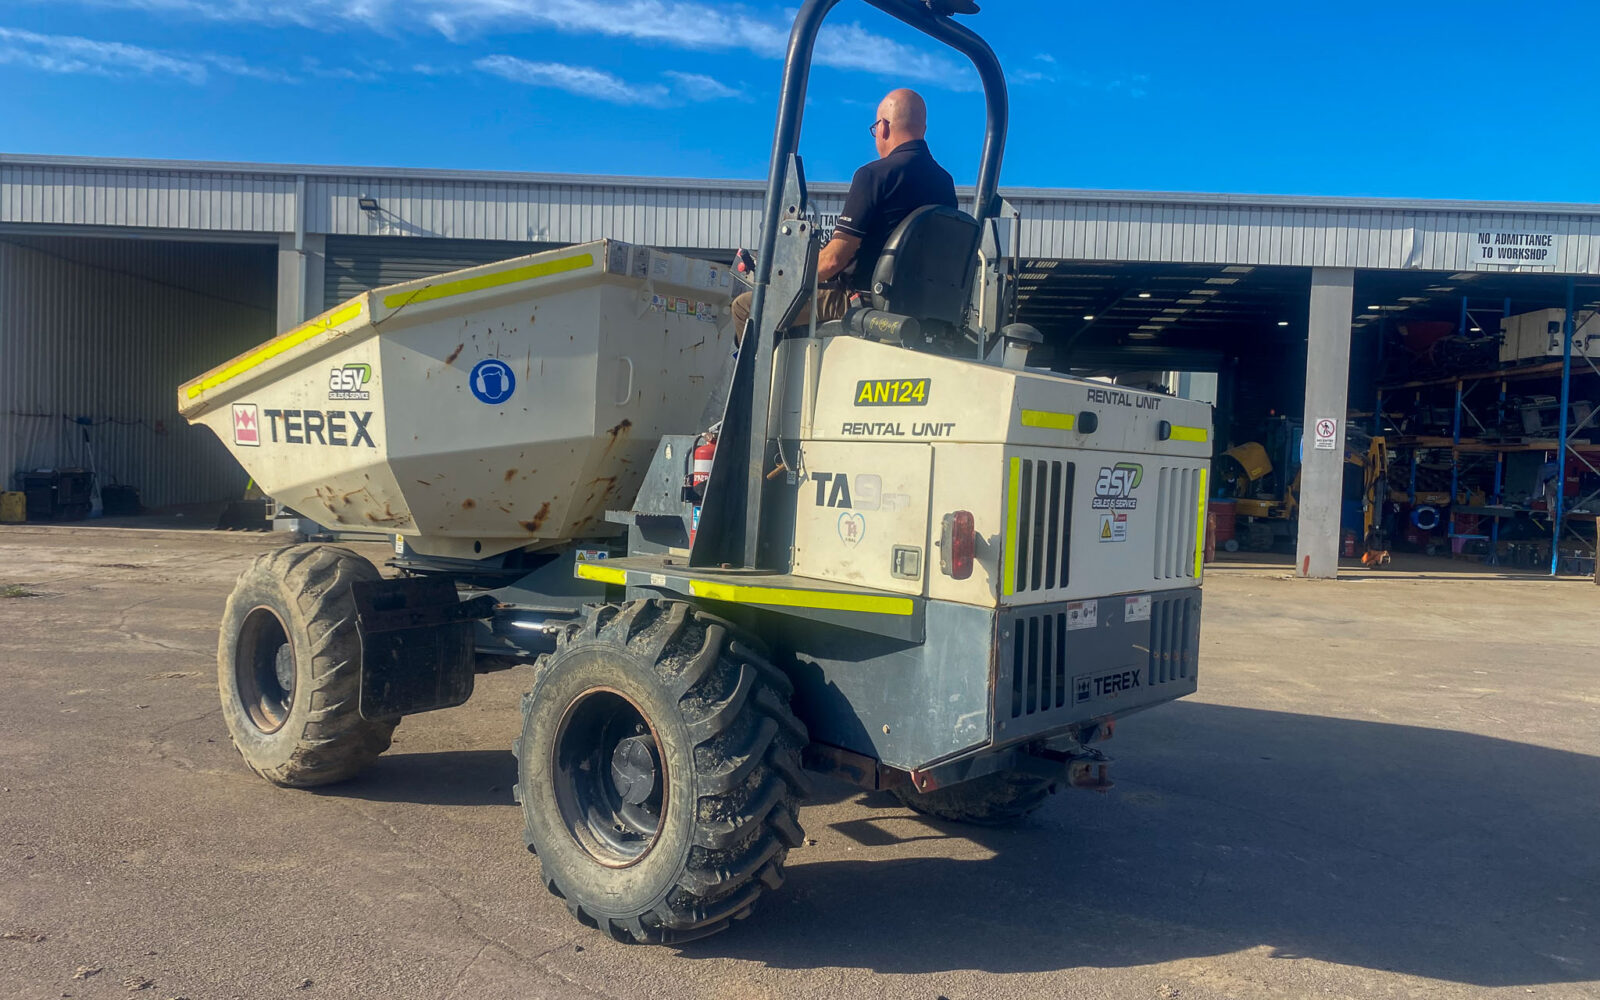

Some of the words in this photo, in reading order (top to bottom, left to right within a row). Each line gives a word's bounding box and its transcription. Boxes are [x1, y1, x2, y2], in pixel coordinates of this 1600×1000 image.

[1478, 232, 1490, 244] NO
[1495, 233, 1552, 247] ADMITTANCE
[1482, 246, 1493, 259] TO
[1498, 247, 1547, 260] WORKSHOP
[857, 380, 925, 403] AN124
[1087, 388, 1132, 407] RENTAL
[1135, 396, 1161, 410] UNIT
[264, 408, 376, 448] TEREX
[841, 422, 905, 436] RENTAL
[911, 423, 956, 437] UNIT
[1094, 669, 1140, 697] TEREX
